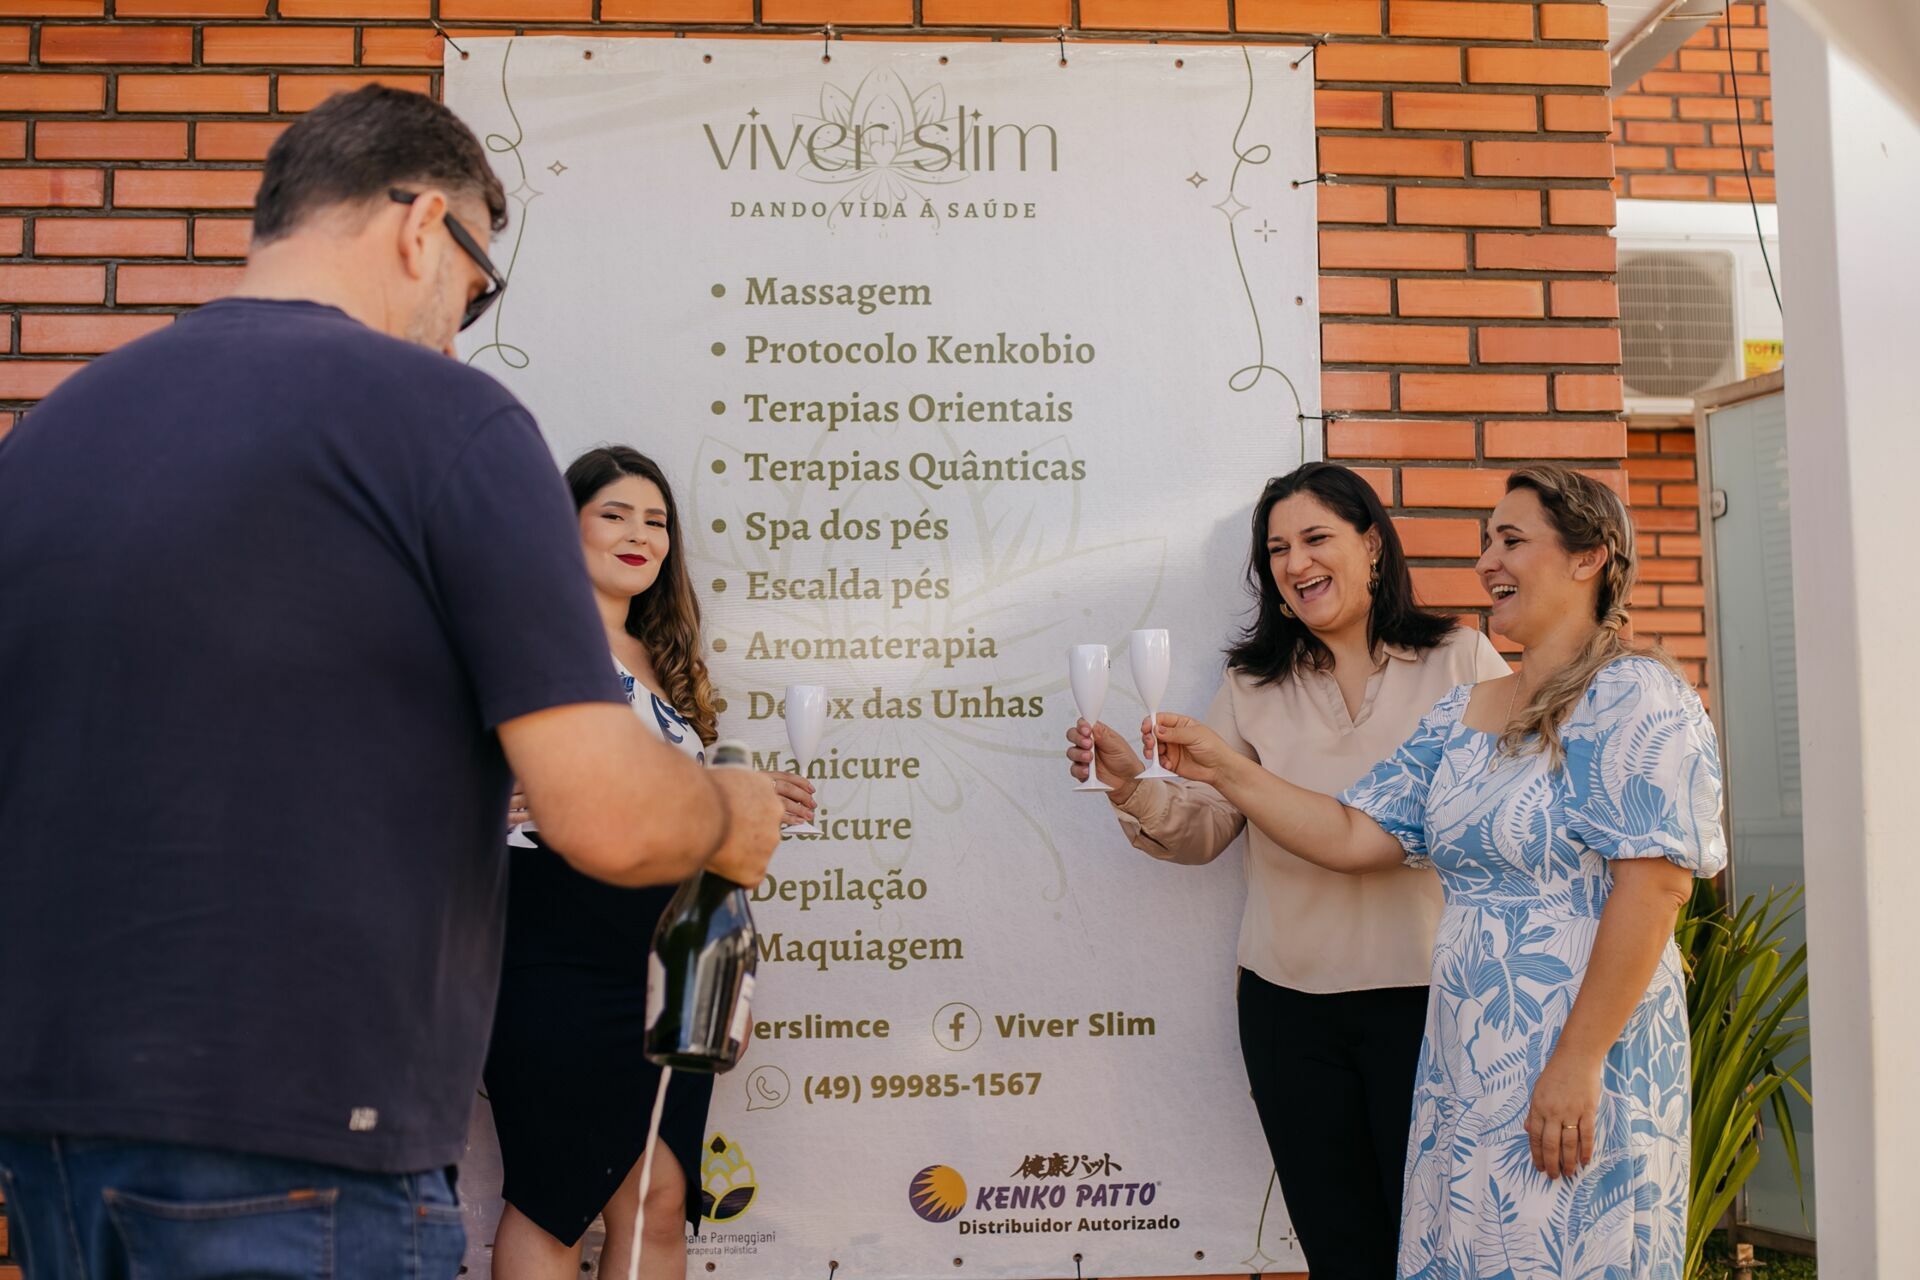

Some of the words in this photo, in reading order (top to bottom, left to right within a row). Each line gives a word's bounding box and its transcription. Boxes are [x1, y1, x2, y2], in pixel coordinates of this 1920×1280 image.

[702, 105, 889, 171] viver
[913, 104, 1058, 172] slim
[730, 201, 827, 218] DANDO
[841, 201, 907, 218] VIDA
[948, 198, 1036, 219] SAÚDE
[745, 277, 932, 315] Massagem
[745, 332, 917, 364] Protocolo
[927, 332, 1095, 364] Kenkobio
[744, 391, 899, 432] Terapias
[908, 391, 1073, 423] Orientais
[744, 450, 899, 490] Terapias
[909, 450, 1087, 490] Quânticas
[746, 511, 811, 549] Spa
[820, 509, 881, 541] dos
[891, 508, 949, 549] pés
[746, 568, 882, 601] Escalda
[892, 568, 950, 609] pés
[744, 628, 998, 668] Aromaterapia
[862, 686, 922, 719] das
[932, 686, 1044, 719] Unhas
[750, 868, 928, 911] Depilação
[757, 929, 964, 971] Maquiagem
[754, 1014, 890, 1040] erslimce
[995, 1013, 1079, 1038] Viver
[1088, 1012, 1156, 1036] Slim
[804, 1076, 861, 1104] (49)
[871, 1072, 1042, 1098] 99985-1567
[975, 1185, 1066, 1211] KENKO
[685, 1234, 707, 1244] ane
[711, 1231, 775, 1246] Parmeggiani
[959, 1218, 1072, 1235] Distribuidor
[1077, 1215, 1181, 1232] Autorizado
[687, 1246, 722, 1255] erapeuta
